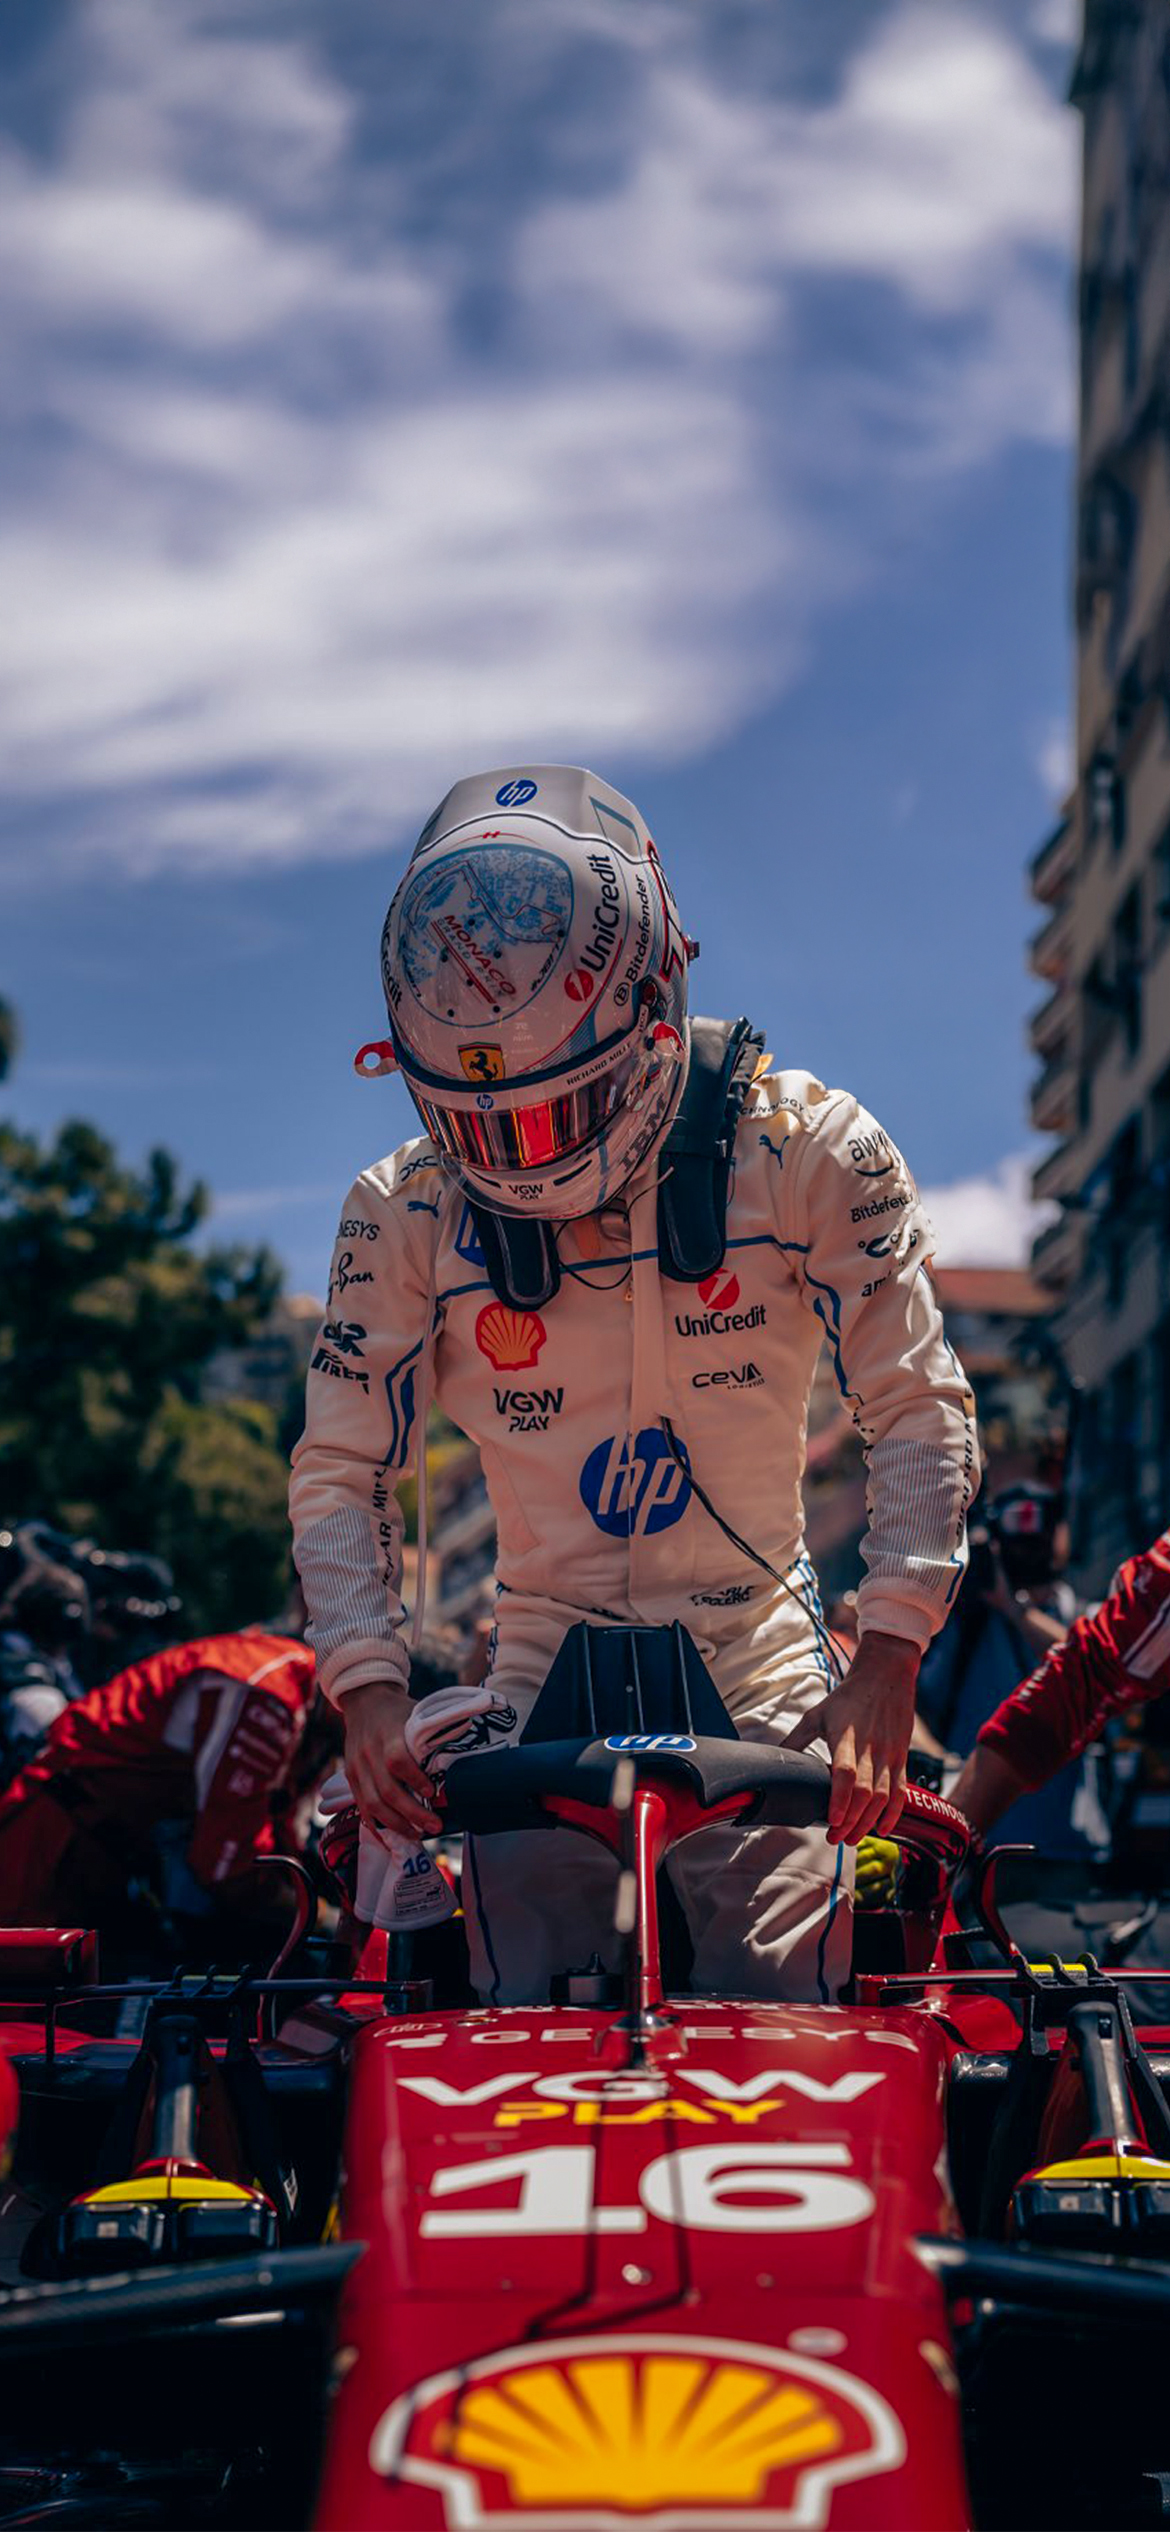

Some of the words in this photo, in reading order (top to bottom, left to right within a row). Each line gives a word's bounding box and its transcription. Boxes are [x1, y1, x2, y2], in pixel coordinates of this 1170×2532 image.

[497, 779, 537, 807] hp
[580, 854, 620, 972] UniCredit
[626, 875, 651, 983] Bitdefender
[444, 915, 517, 995] MONACO
[566, 1061, 608, 1086] RICHARD
[478, 1094, 493, 1110] hp
[508, 1184, 543, 1195] VGW
[675, 1304, 766, 1337] UniCredit
[493, 1387, 564, 1415] VGW
[509, 1415, 550, 1432] PLAY
[588, 1429, 690, 1537] hp
[402, 1851, 431, 1878] 16
[470, 2026, 920, 2053] GEESYS
[396, 2069, 888, 2106] VGW
[493, 2098, 786, 2127] PLAY
[419, 2142, 877, 2238] 16
